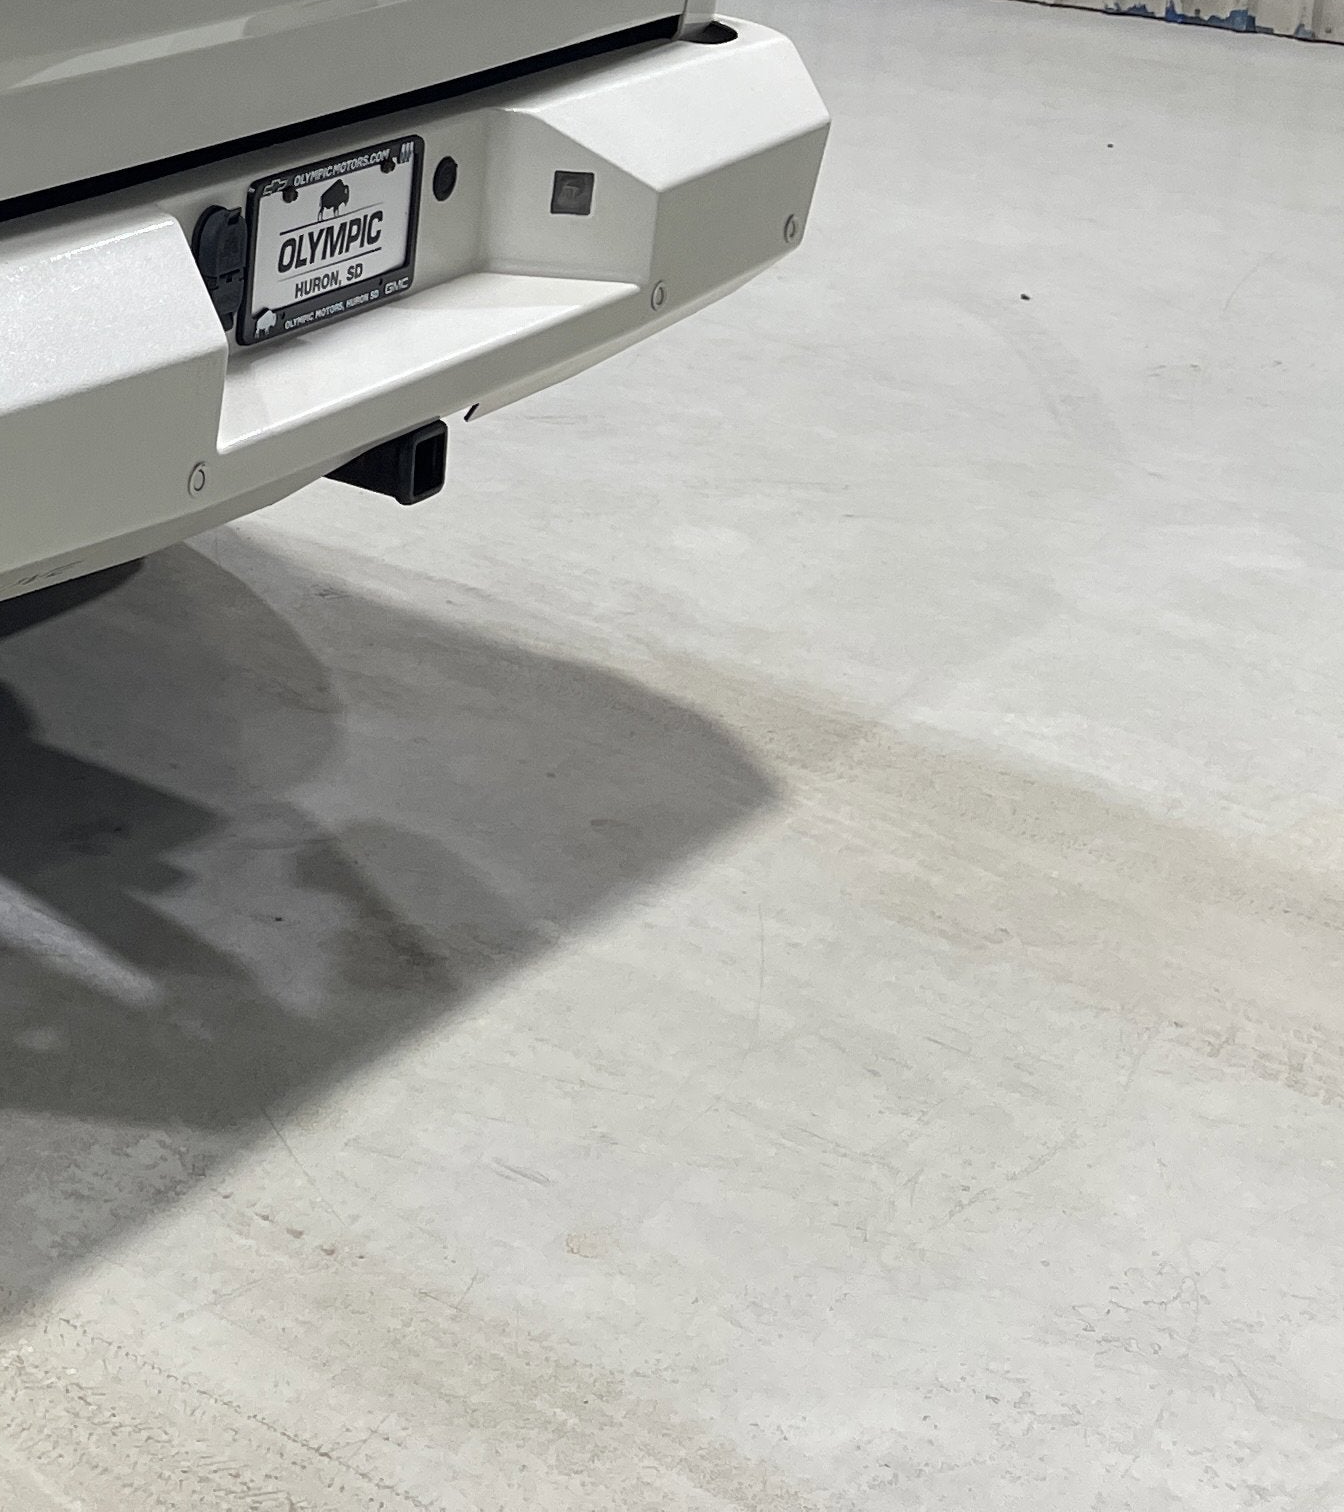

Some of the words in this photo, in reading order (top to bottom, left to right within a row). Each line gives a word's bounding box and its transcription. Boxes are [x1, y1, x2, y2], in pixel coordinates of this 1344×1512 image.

[277, 209, 383, 274] OLYMPIC
[295, 270, 342, 299] HURON,
[346, 262, 363, 282] SD
[385, 277, 409, 295] GMC
[284, 312, 314, 329] OLYMPIC
